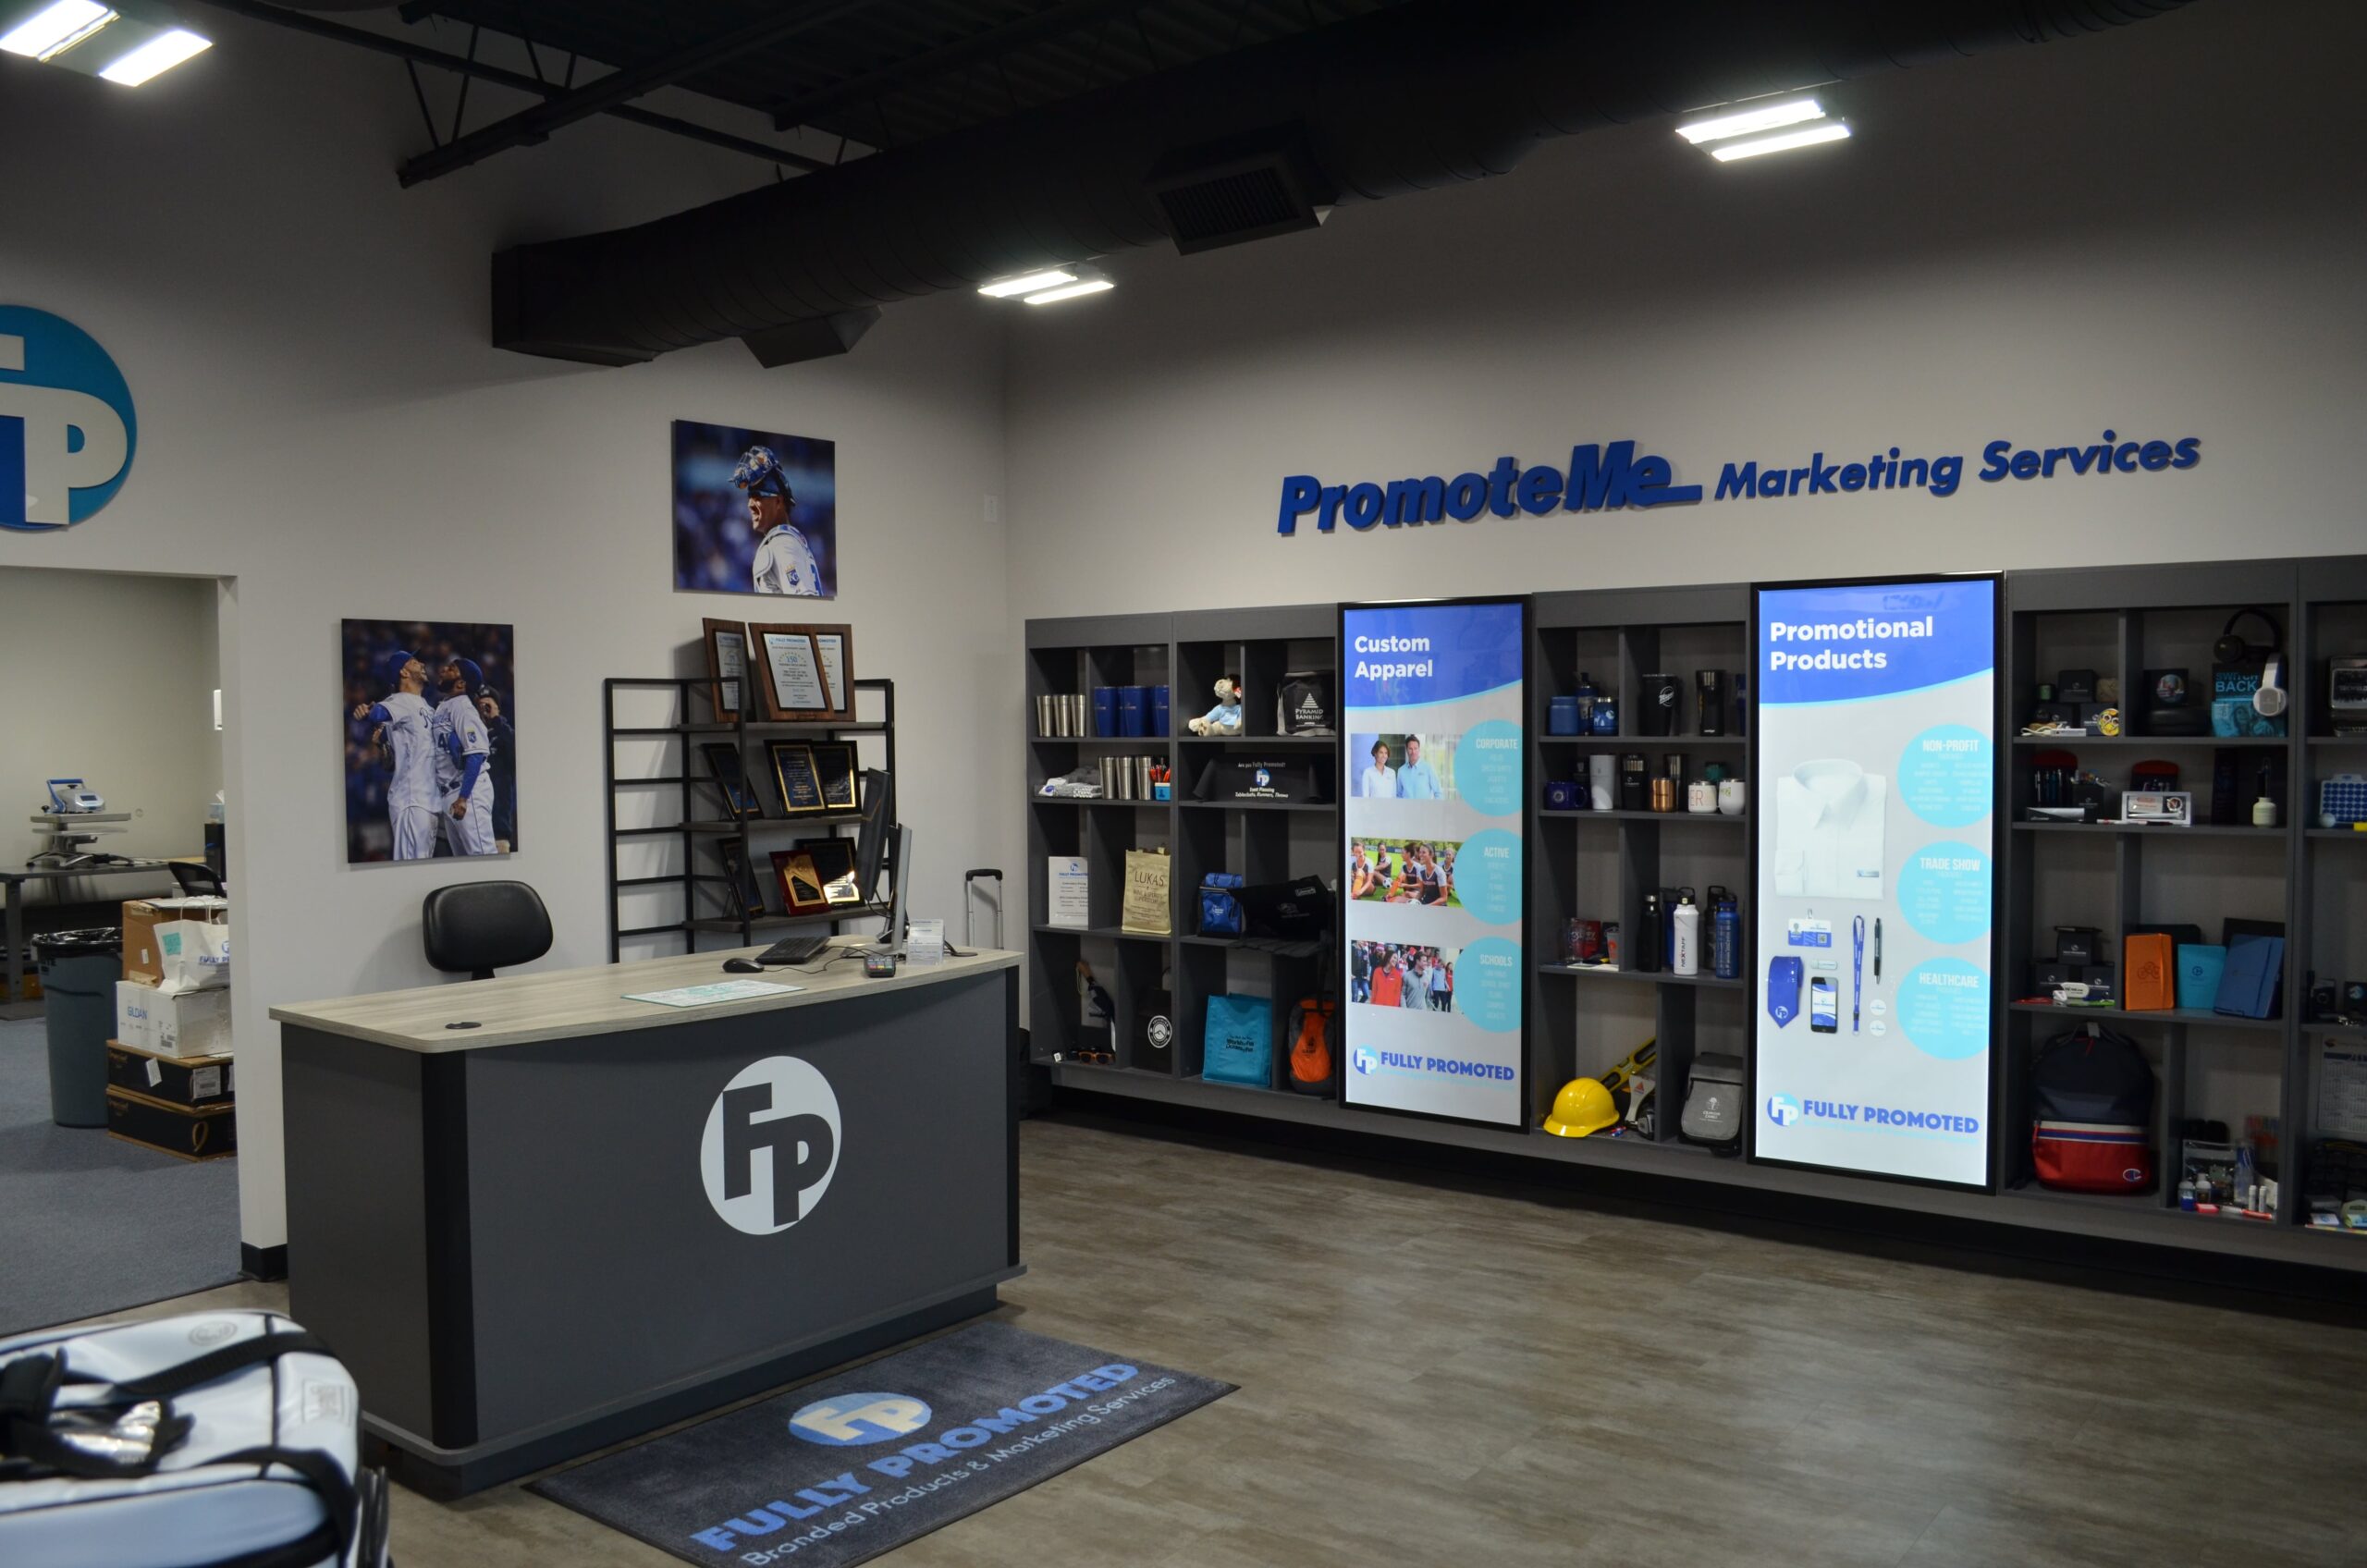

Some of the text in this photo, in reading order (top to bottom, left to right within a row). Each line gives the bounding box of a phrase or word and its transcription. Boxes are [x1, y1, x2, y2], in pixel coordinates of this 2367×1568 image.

[1278, 430, 2201, 534] PromoteMe Marketing Services
[1770, 615, 1933, 642] Promotional
[1355, 635, 1430, 653] Custom
[1355, 659, 1433, 680] Apparel
[1770, 649, 1888, 671] Products
[2215, 680, 2257, 692] BACK
[1476, 738, 1519, 750] CORPORATE
[1923, 740, 1979, 752] NON-PROFIT
[1483, 845, 1510, 859] ACTIVE
[1919, 857, 1981, 872] TRADE SHOW
[1134, 870, 1164, 888] LUKAS
[1479, 954, 1513, 967] SCHOOLS
[1919, 972, 1980, 988] HEALTHCARE
[1380, 1050, 1424, 1071] FULLY
[1426, 1057, 1515, 1082] PROMOTED
[1803, 1099, 1858, 1121] FULLY
[1864, 1106, 1980, 1134] PROMOTED
[723, 1082, 834, 1227] FP
[792, 1398, 926, 1440] FP
[690, 1363, 1138, 1552] FULLY PROMOTED
[741, 1376, 1176, 1566] Branded Products & Marketing Services
